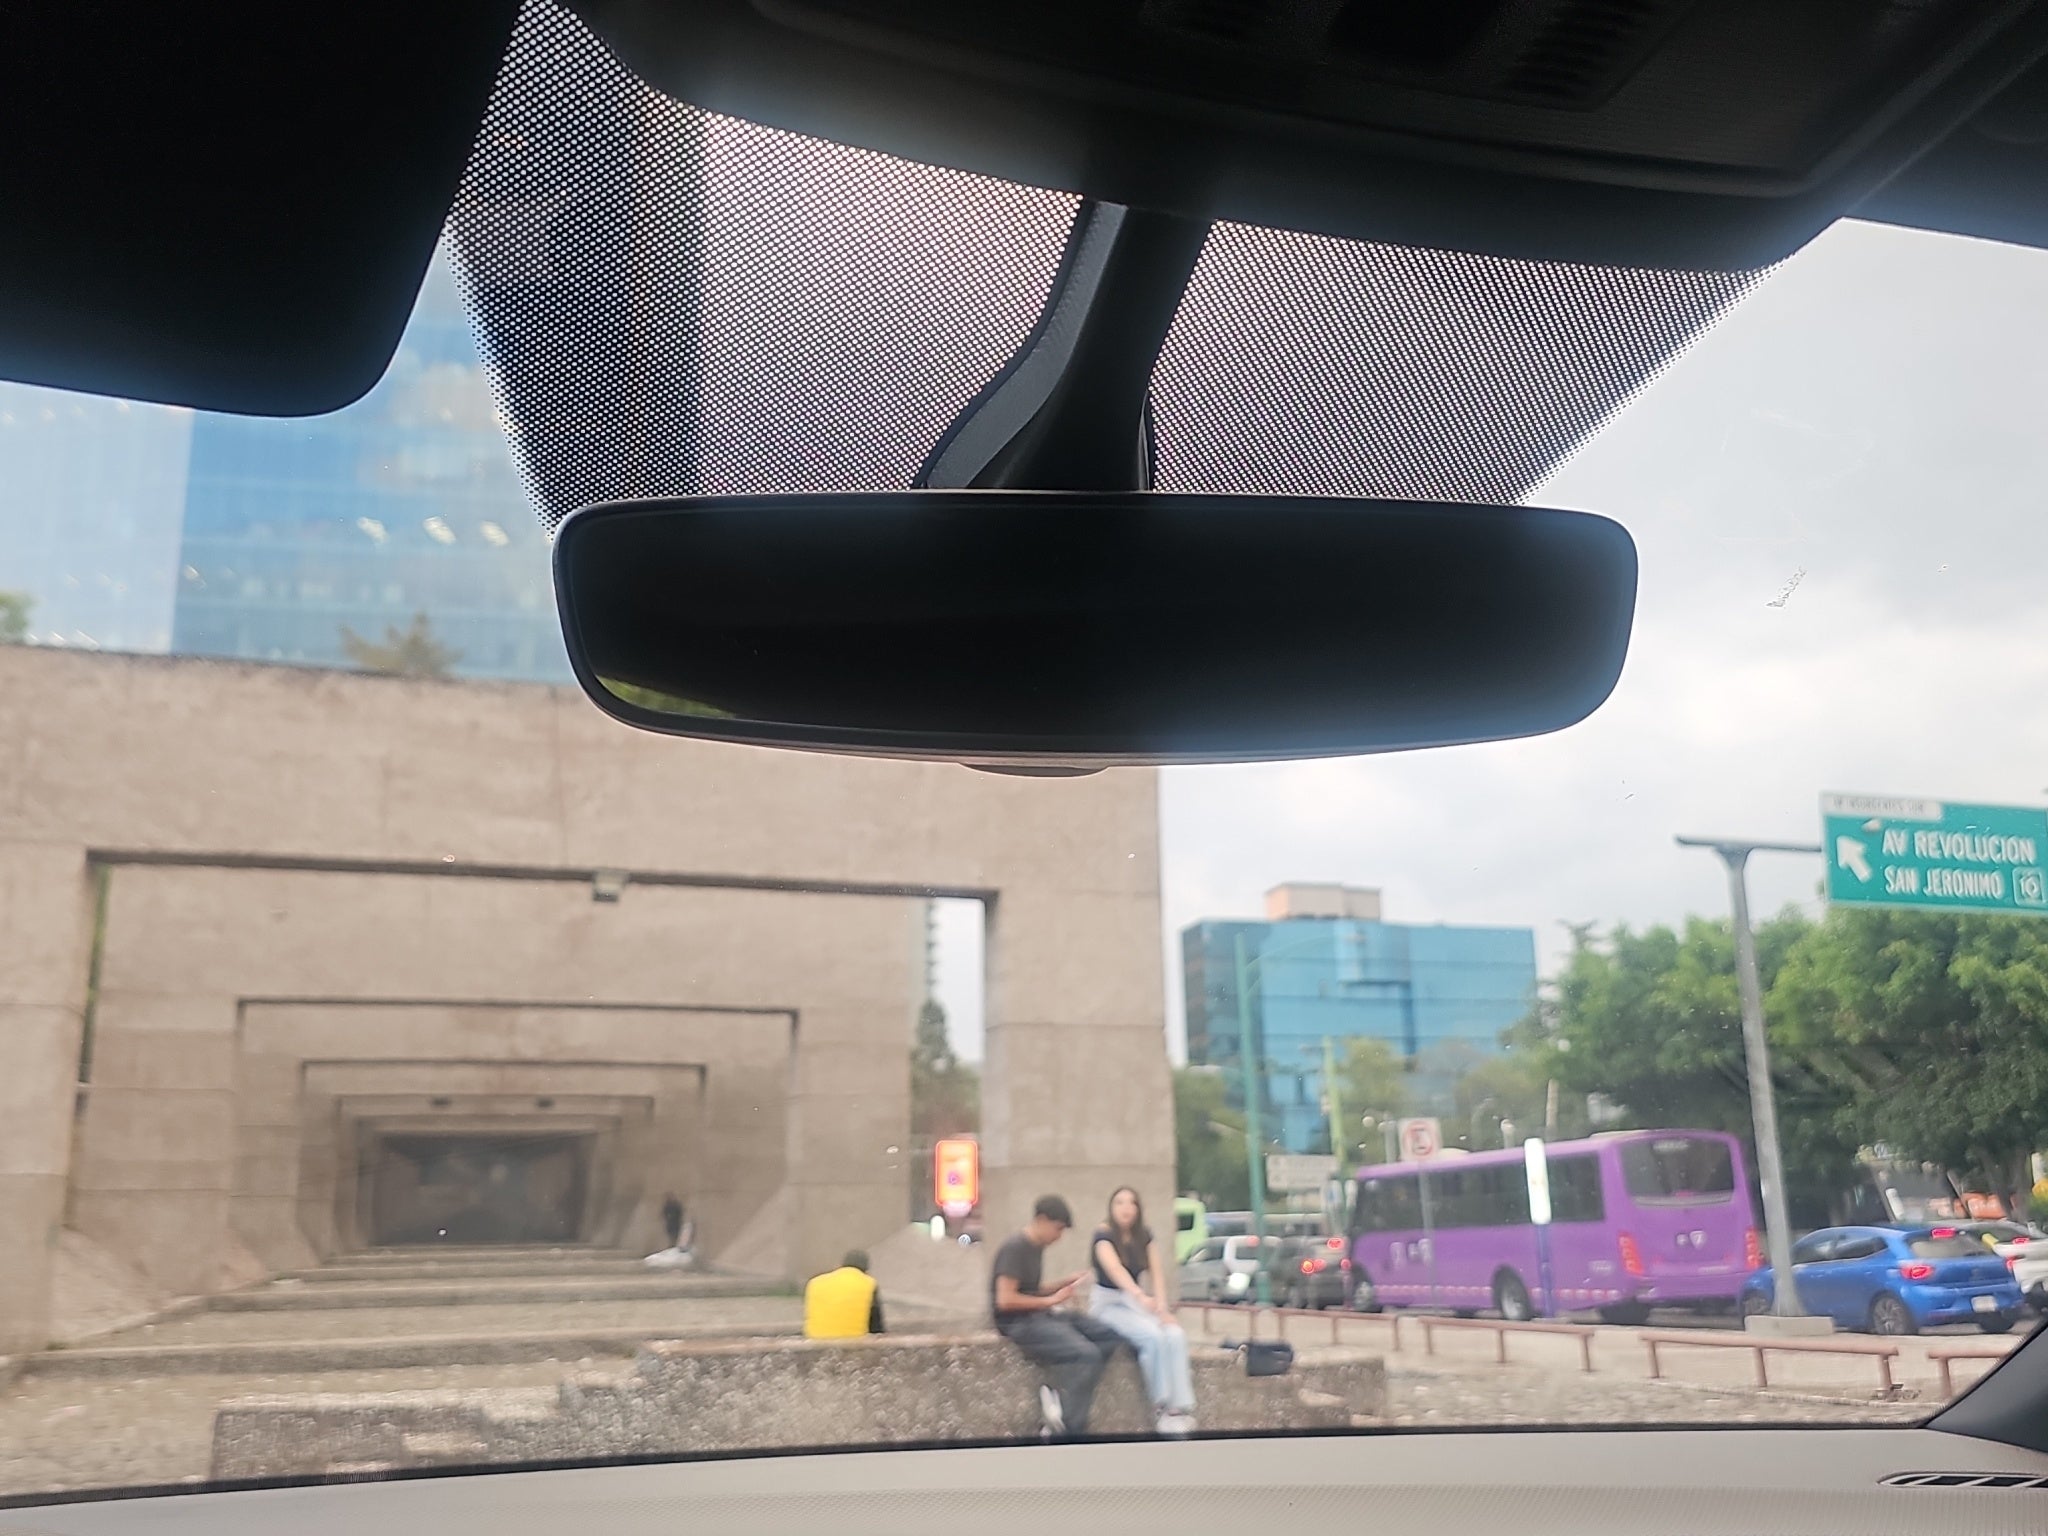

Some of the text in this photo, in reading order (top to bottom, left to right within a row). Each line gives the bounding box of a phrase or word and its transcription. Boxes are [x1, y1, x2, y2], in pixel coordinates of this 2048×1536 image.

[1882, 828, 1909, 856] AV
[1884, 864, 2005, 899] SAN JERONIMO
